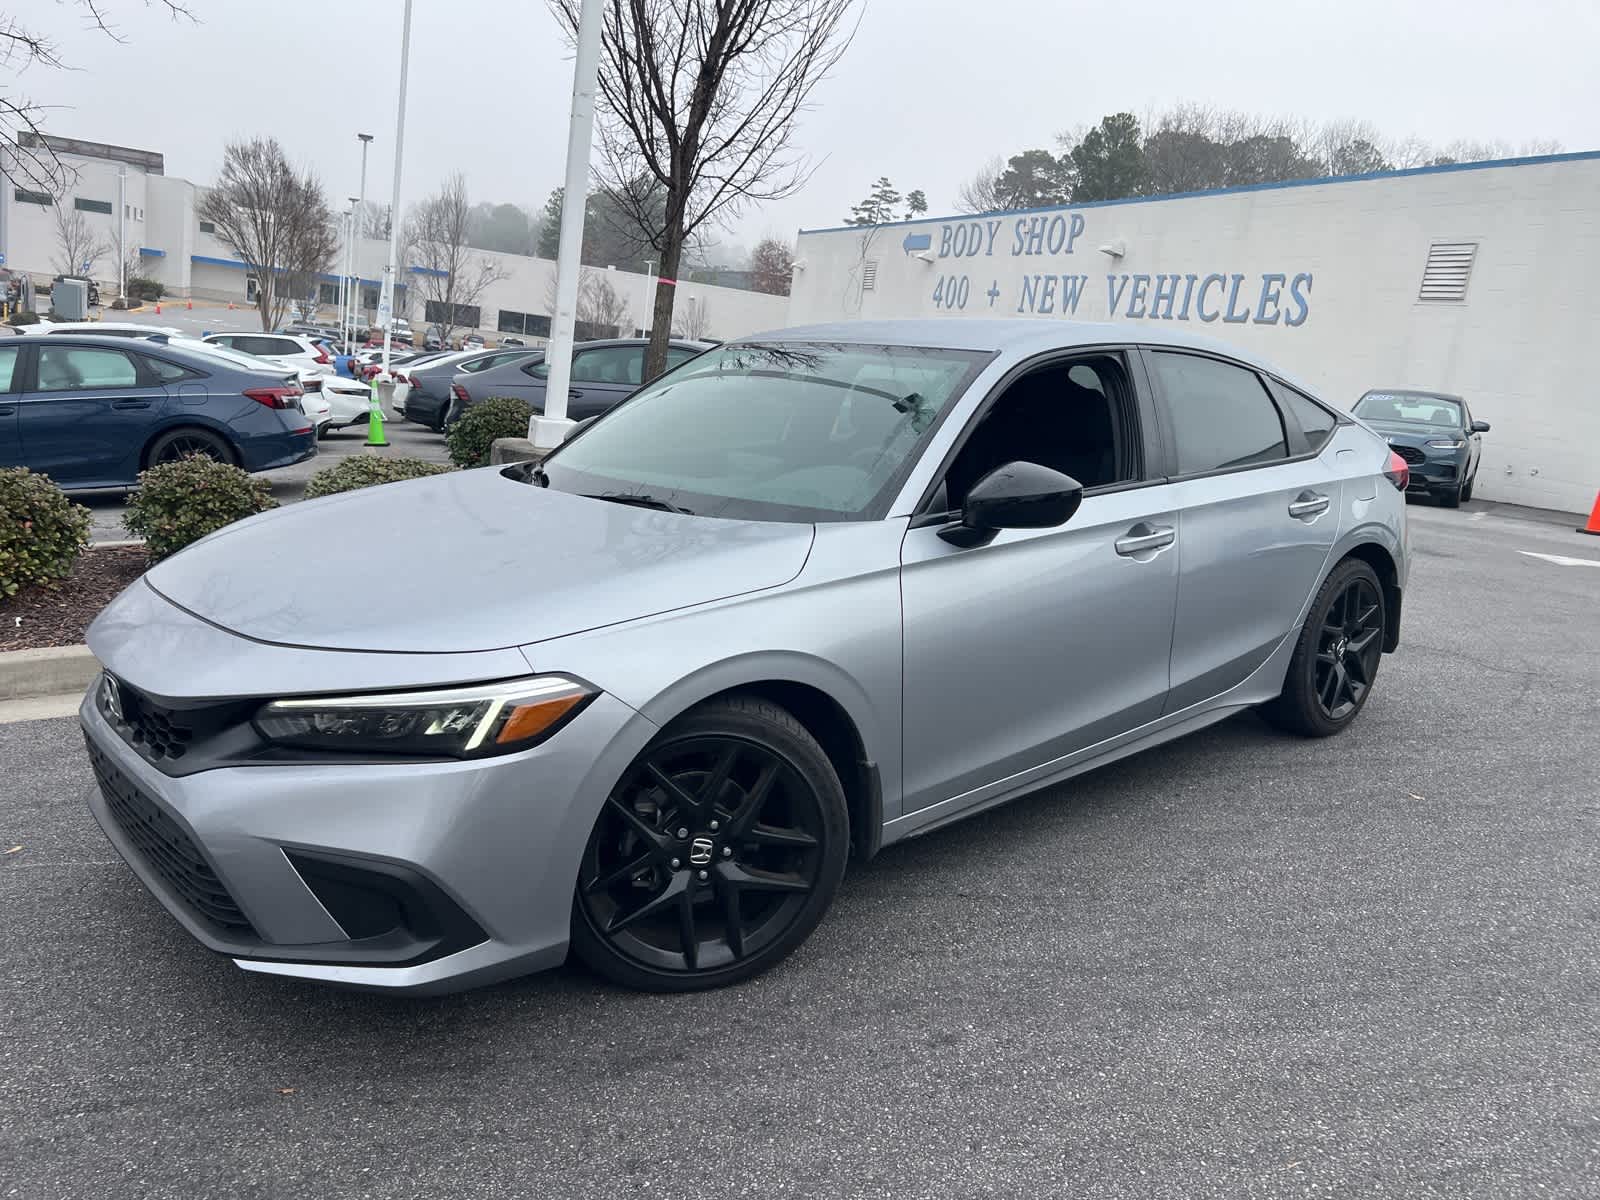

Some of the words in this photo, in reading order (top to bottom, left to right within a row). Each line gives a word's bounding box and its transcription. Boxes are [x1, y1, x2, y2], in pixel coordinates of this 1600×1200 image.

[938, 220, 1002, 258] BODY
[1012, 213, 1085, 256] SHOP
[932, 275, 970, 310] 400
[986, 279, 1001, 307] +
[1017, 274, 1088, 315] NEW
[1106, 272, 1313, 327] VEHICLES
